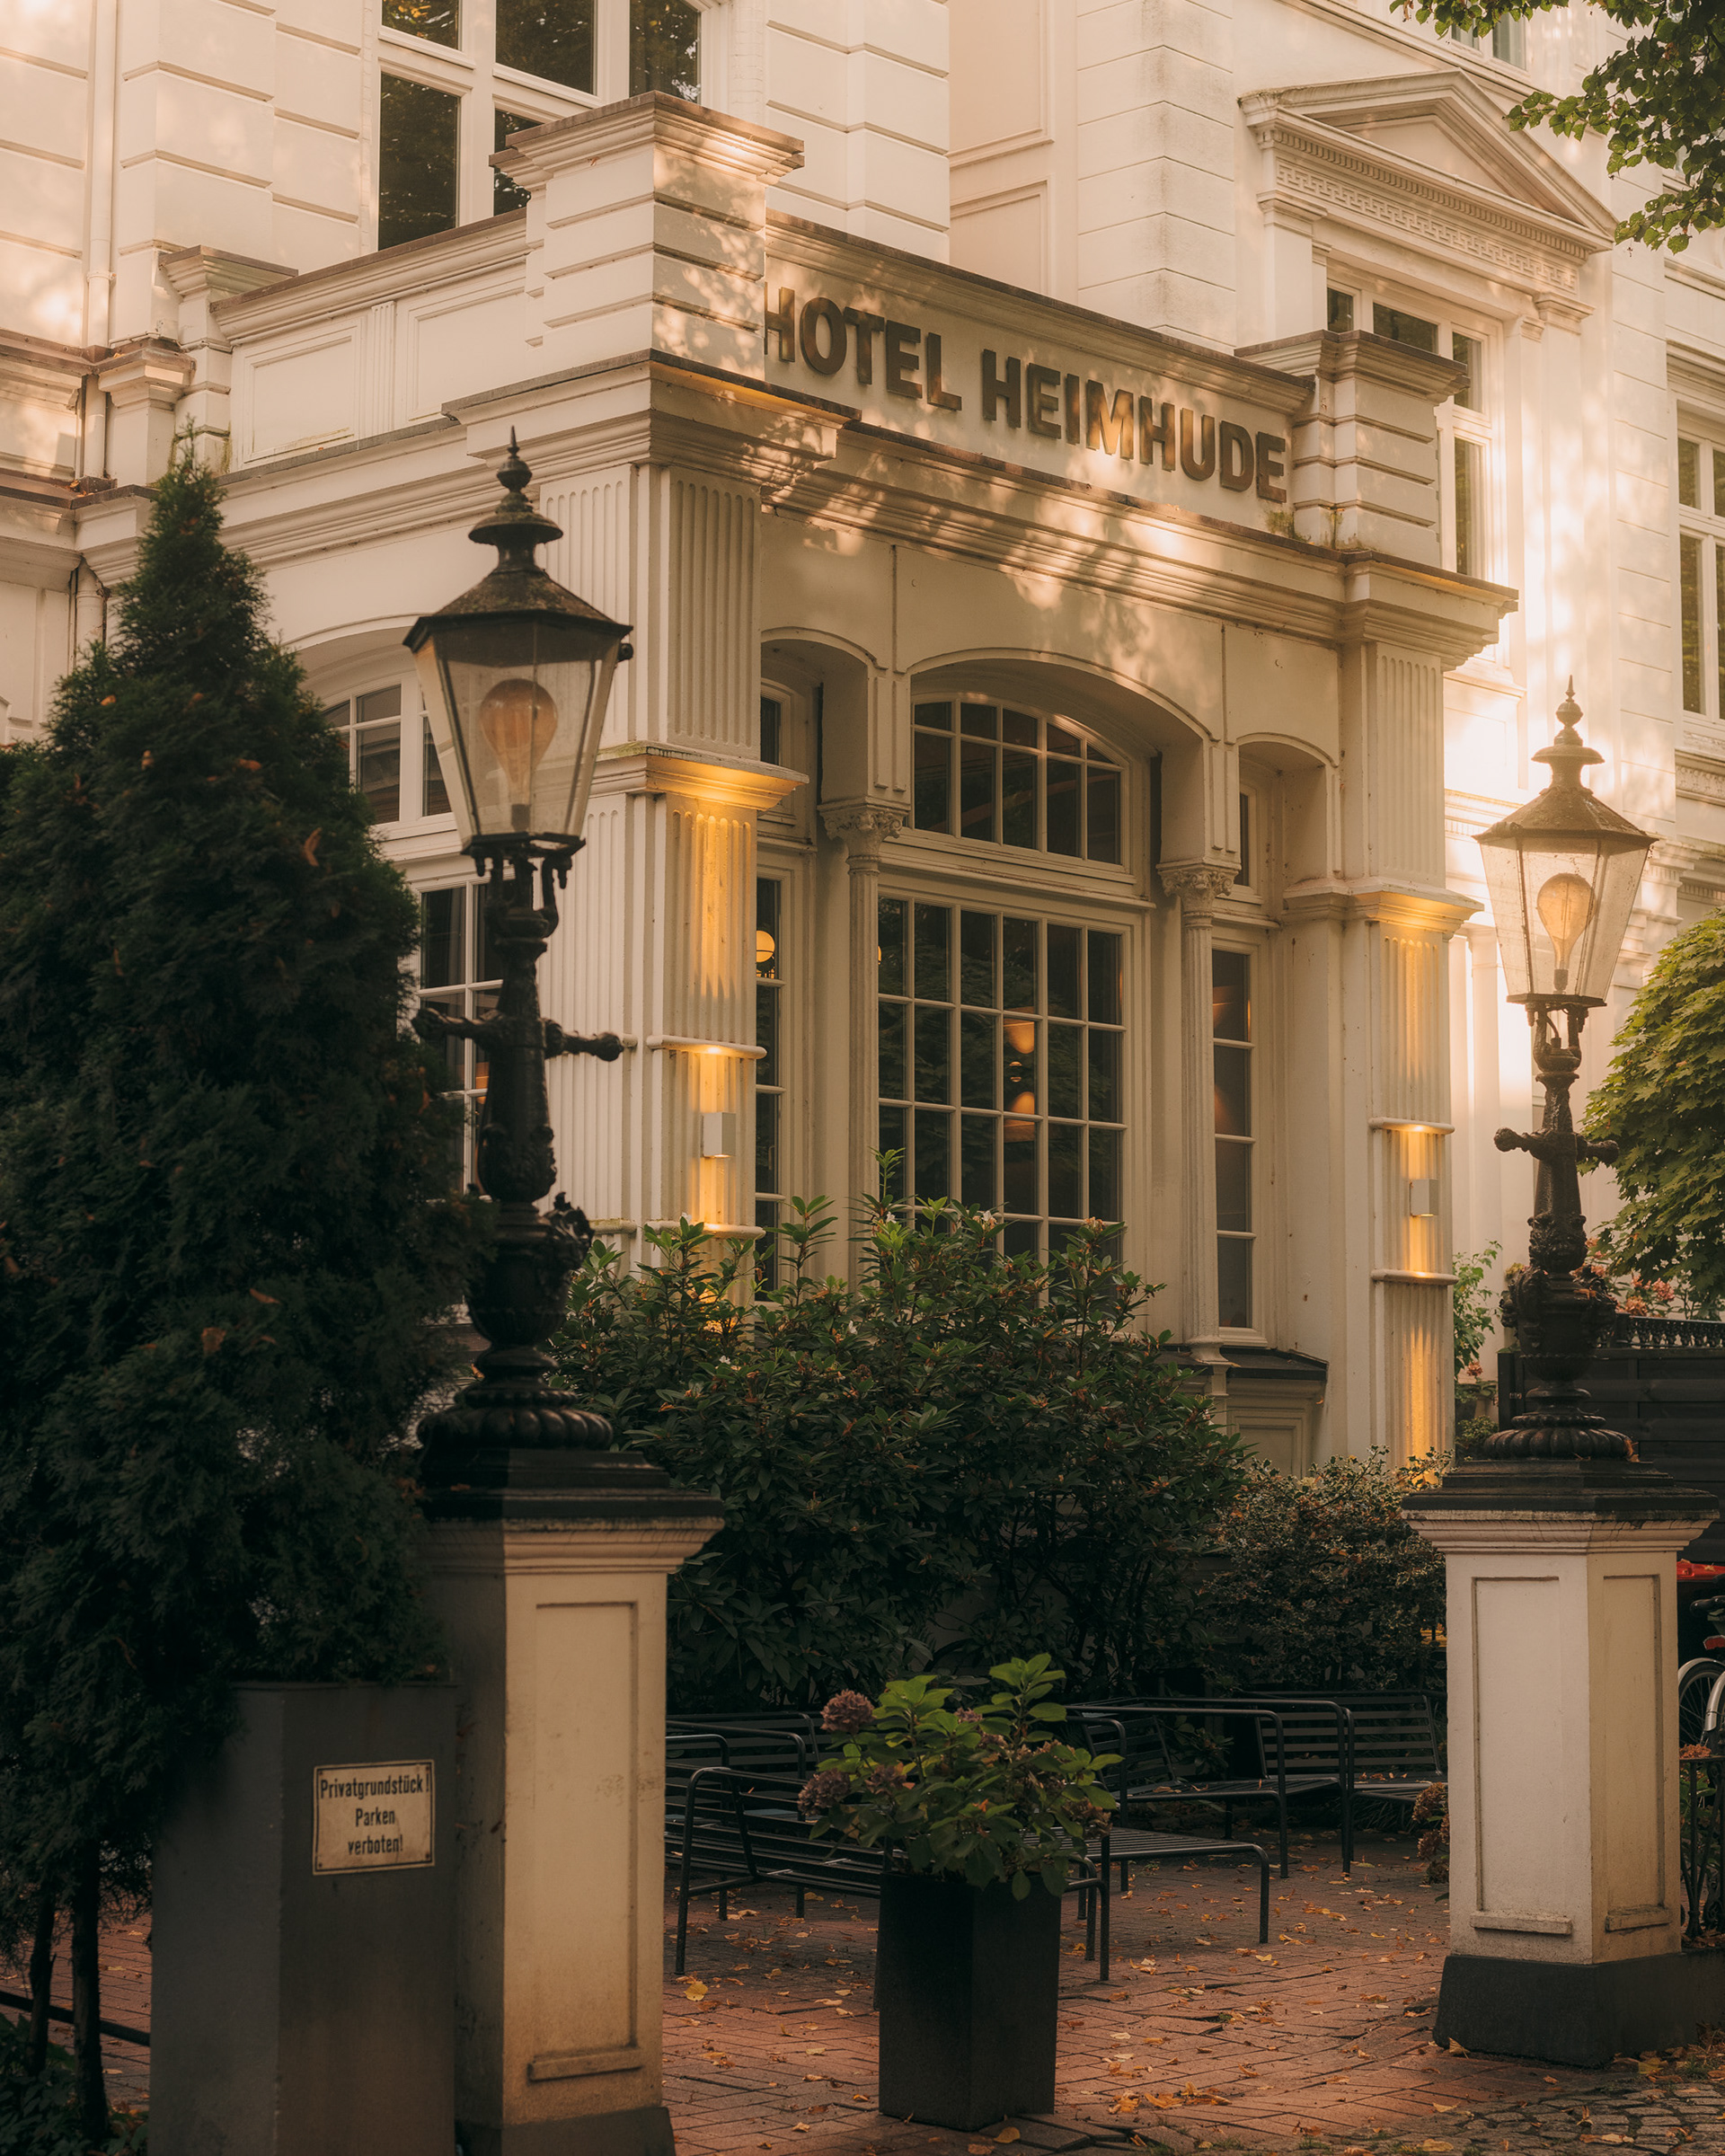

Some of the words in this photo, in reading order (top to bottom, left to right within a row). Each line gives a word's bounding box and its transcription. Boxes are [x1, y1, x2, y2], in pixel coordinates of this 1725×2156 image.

[764, 281, 962, 411] HOTEL
[982, 348, 1287, 504] HEIMHUDE
[355, 1807, 395, 1827] Parken
[348, 1833, 403, 1855] verboten!
